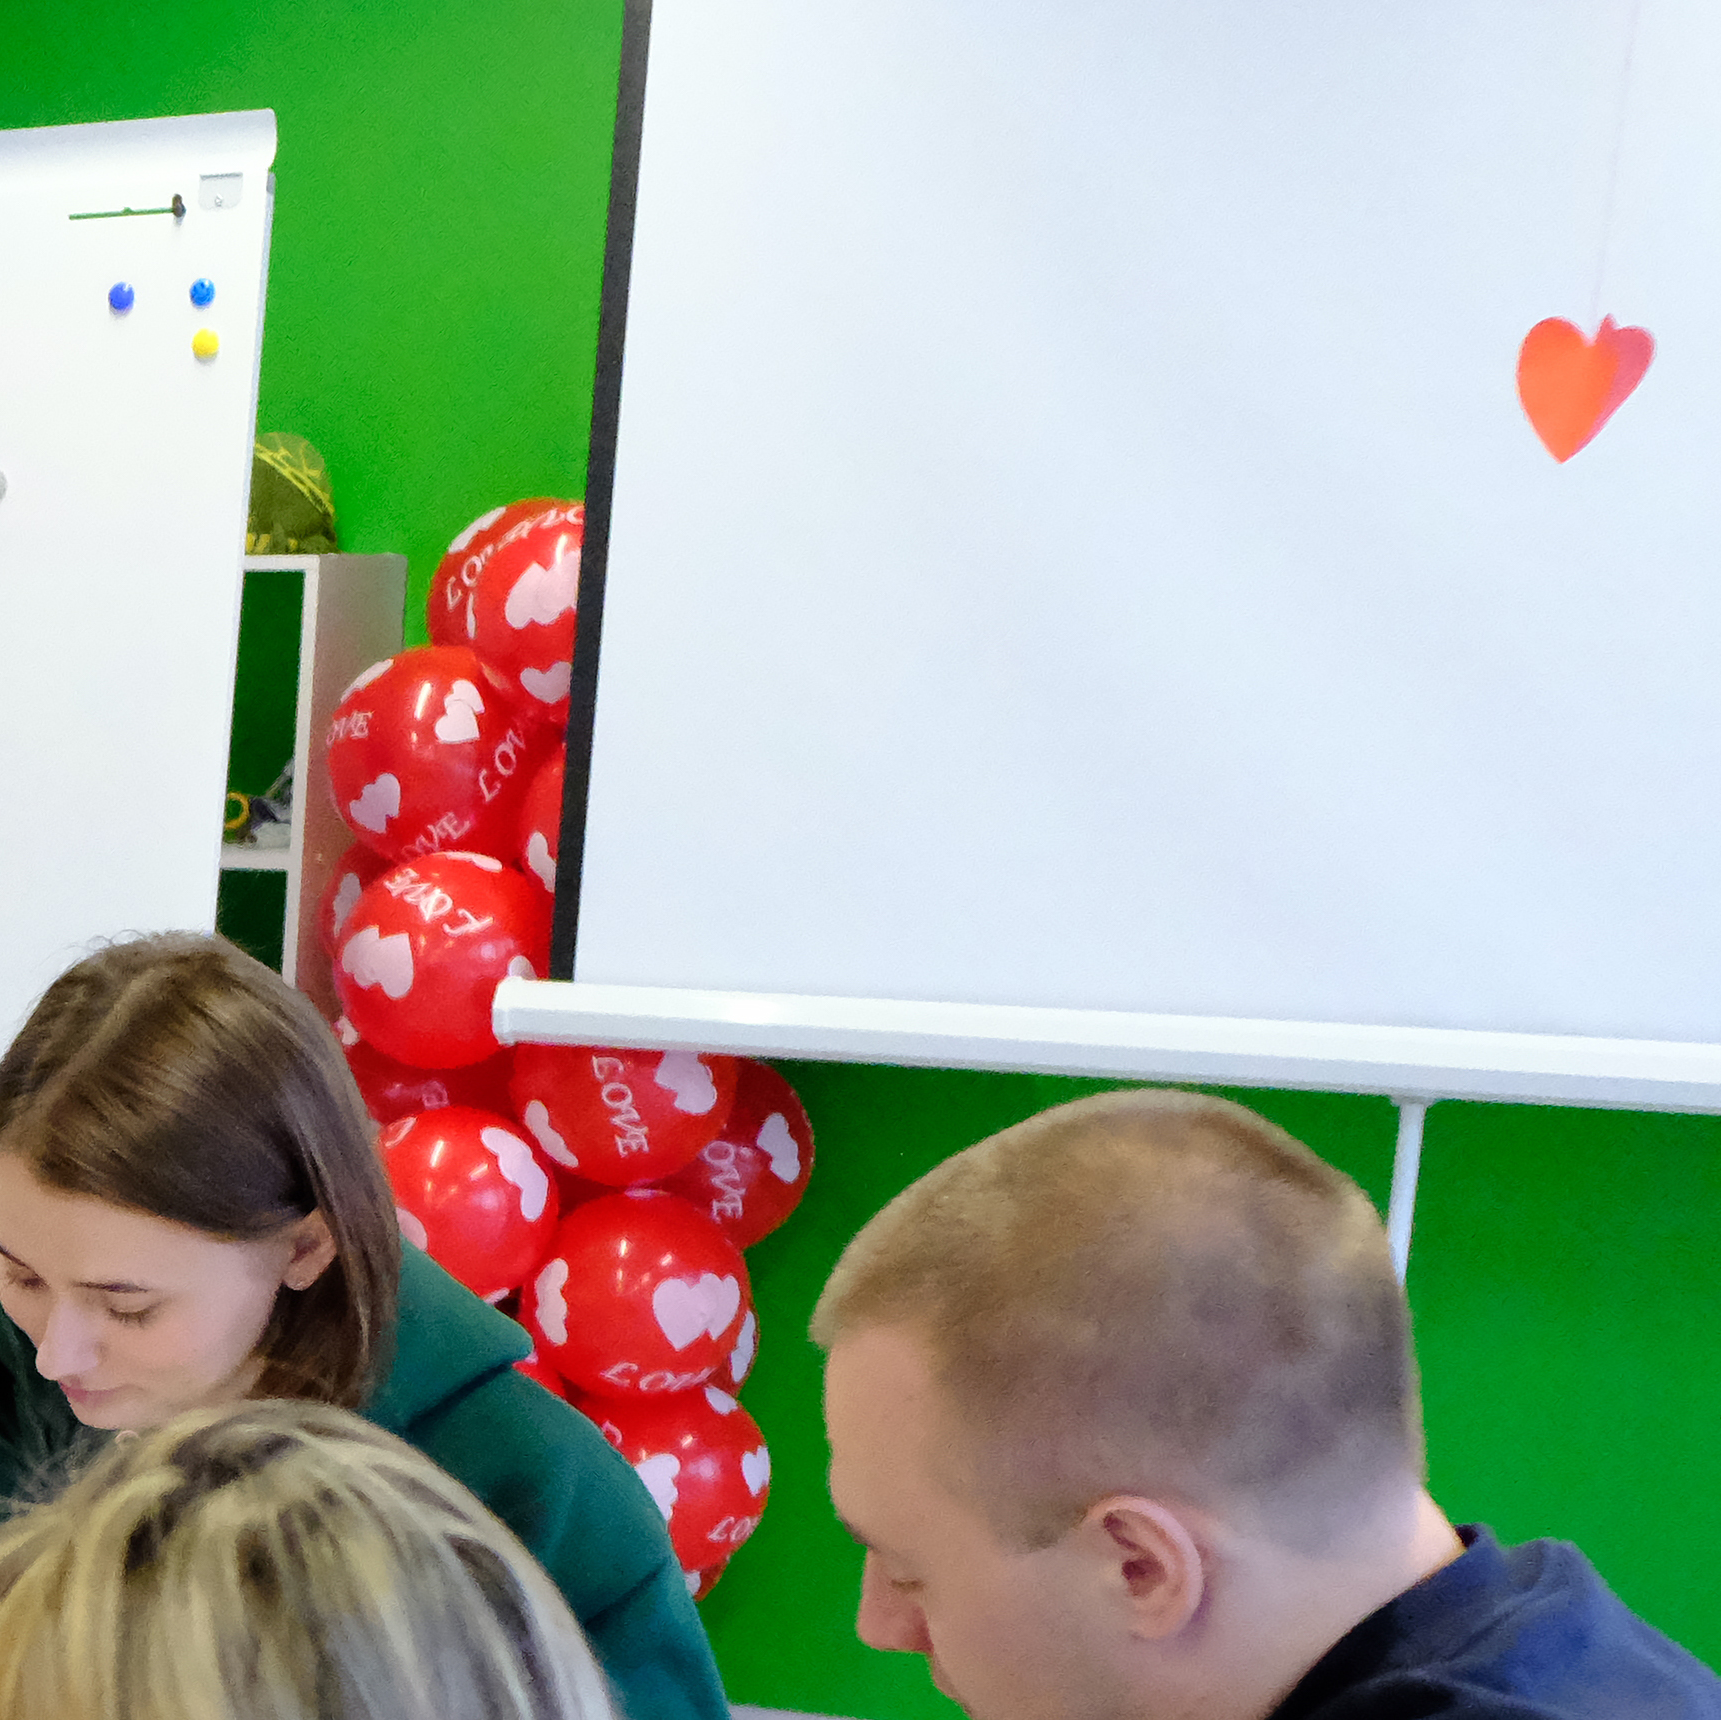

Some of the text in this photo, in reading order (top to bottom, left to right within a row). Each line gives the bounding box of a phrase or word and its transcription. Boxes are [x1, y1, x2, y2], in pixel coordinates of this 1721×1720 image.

[478, 727, 525, 803] LOV
[591, 1055, 650, 1158] LOVE
[701, 1140, 747, 1225] OVE
